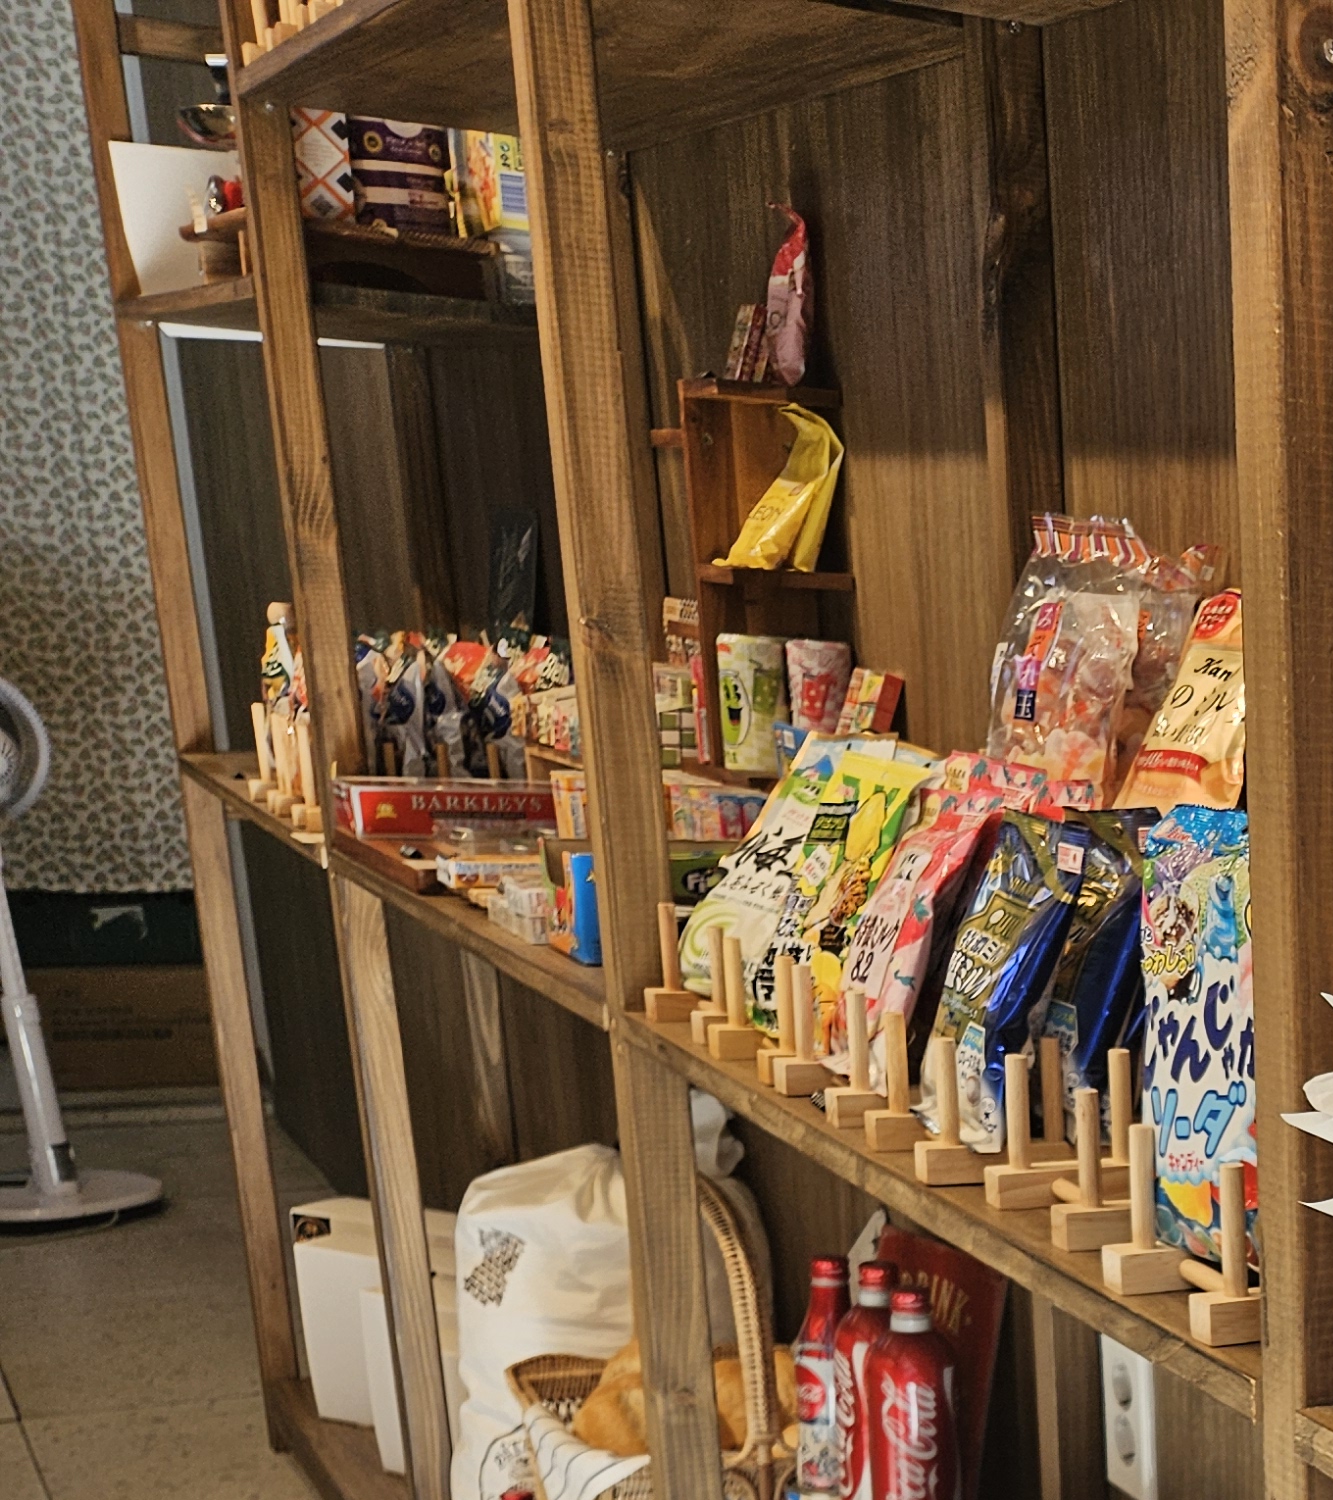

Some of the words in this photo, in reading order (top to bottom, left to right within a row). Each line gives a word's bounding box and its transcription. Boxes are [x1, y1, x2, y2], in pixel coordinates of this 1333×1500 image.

[410, 794, 543, 812] BARKLEYS
[1151, 1080, 1247, 1158] ソーダ
